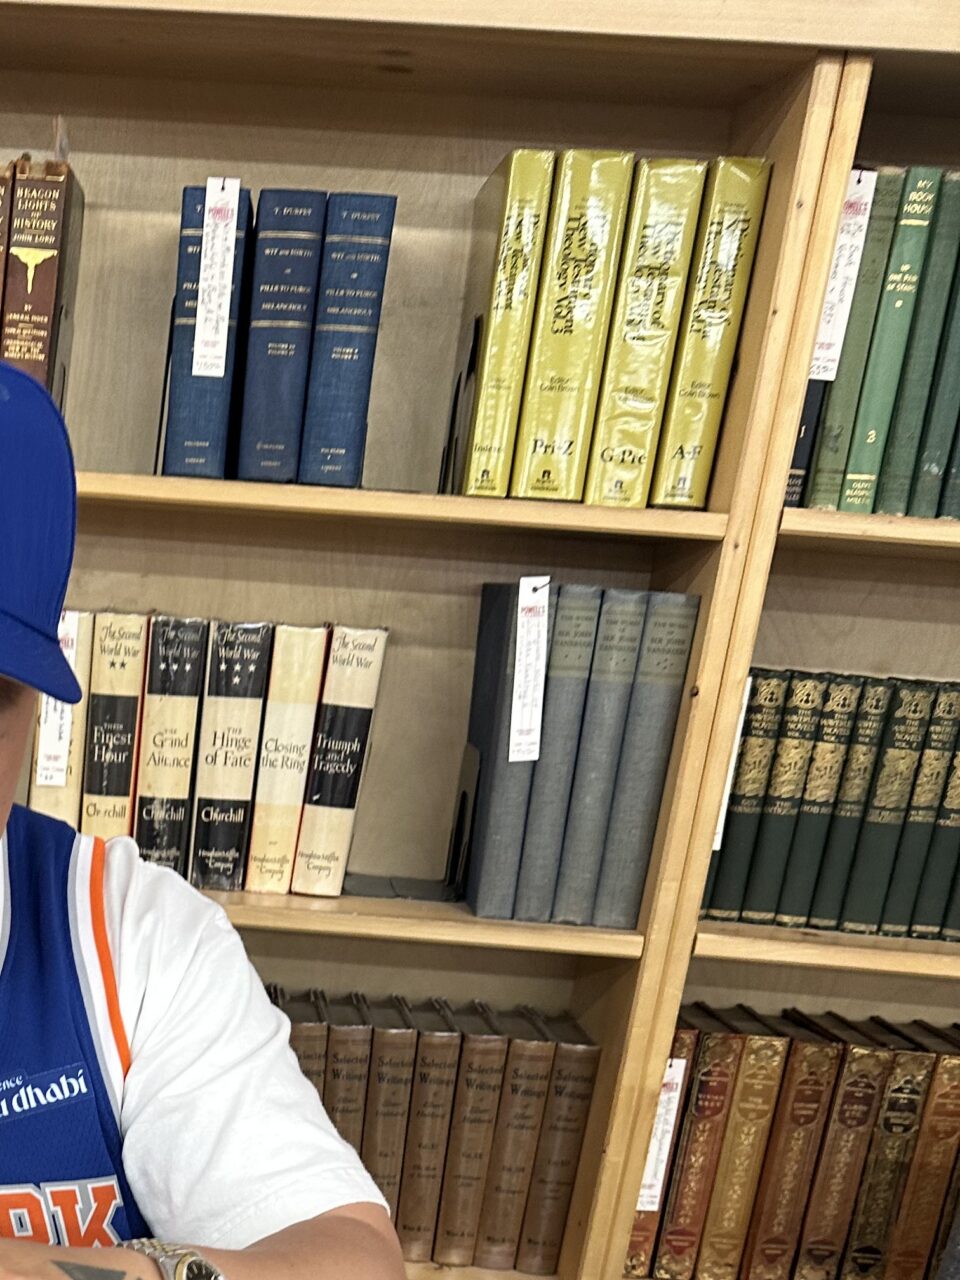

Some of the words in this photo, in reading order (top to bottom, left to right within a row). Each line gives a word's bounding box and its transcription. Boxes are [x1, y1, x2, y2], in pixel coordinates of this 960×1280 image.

[16, 187, 60, 200] BEACON
[917, 180, 933, 190] MY
[18, 199, 56, 212] LIGHTS
[14, 218, 57, 231] HISTORY
[532, 439, 575, 457] Pri-Z
[672, 445, 703, 461] A-F
[118, 624, 142, 641] Second
[100, 642, 122, 656] World
[124, 646, 140, 658] War
[218, 644, 241, 659] World
[243, 648, 261, 660] War
[350, 637, 378, 652] Second
[332, 654, 354, 667] World
[356, 657, 373, 669] War
[94, 726, 132, 746] Finest
[212, 731, 252, 751] Hinge
[316, 733, 360, 755] Triumph
[94, 745, 128, 764] Hour
[264, 738, 306, 756] Closing
[205, 750, 219, 766] of
[223, 752, 251, 768] Fate
[262, 754, 279, 768] the
[280, 756, 306, 774] Ring
[326, 750, 345, 762] and
[313, 754, 357, 778] Tragedy
[202, 806, 244, 825] Churchill
[12, 1068, 88, 1112] dhabi
